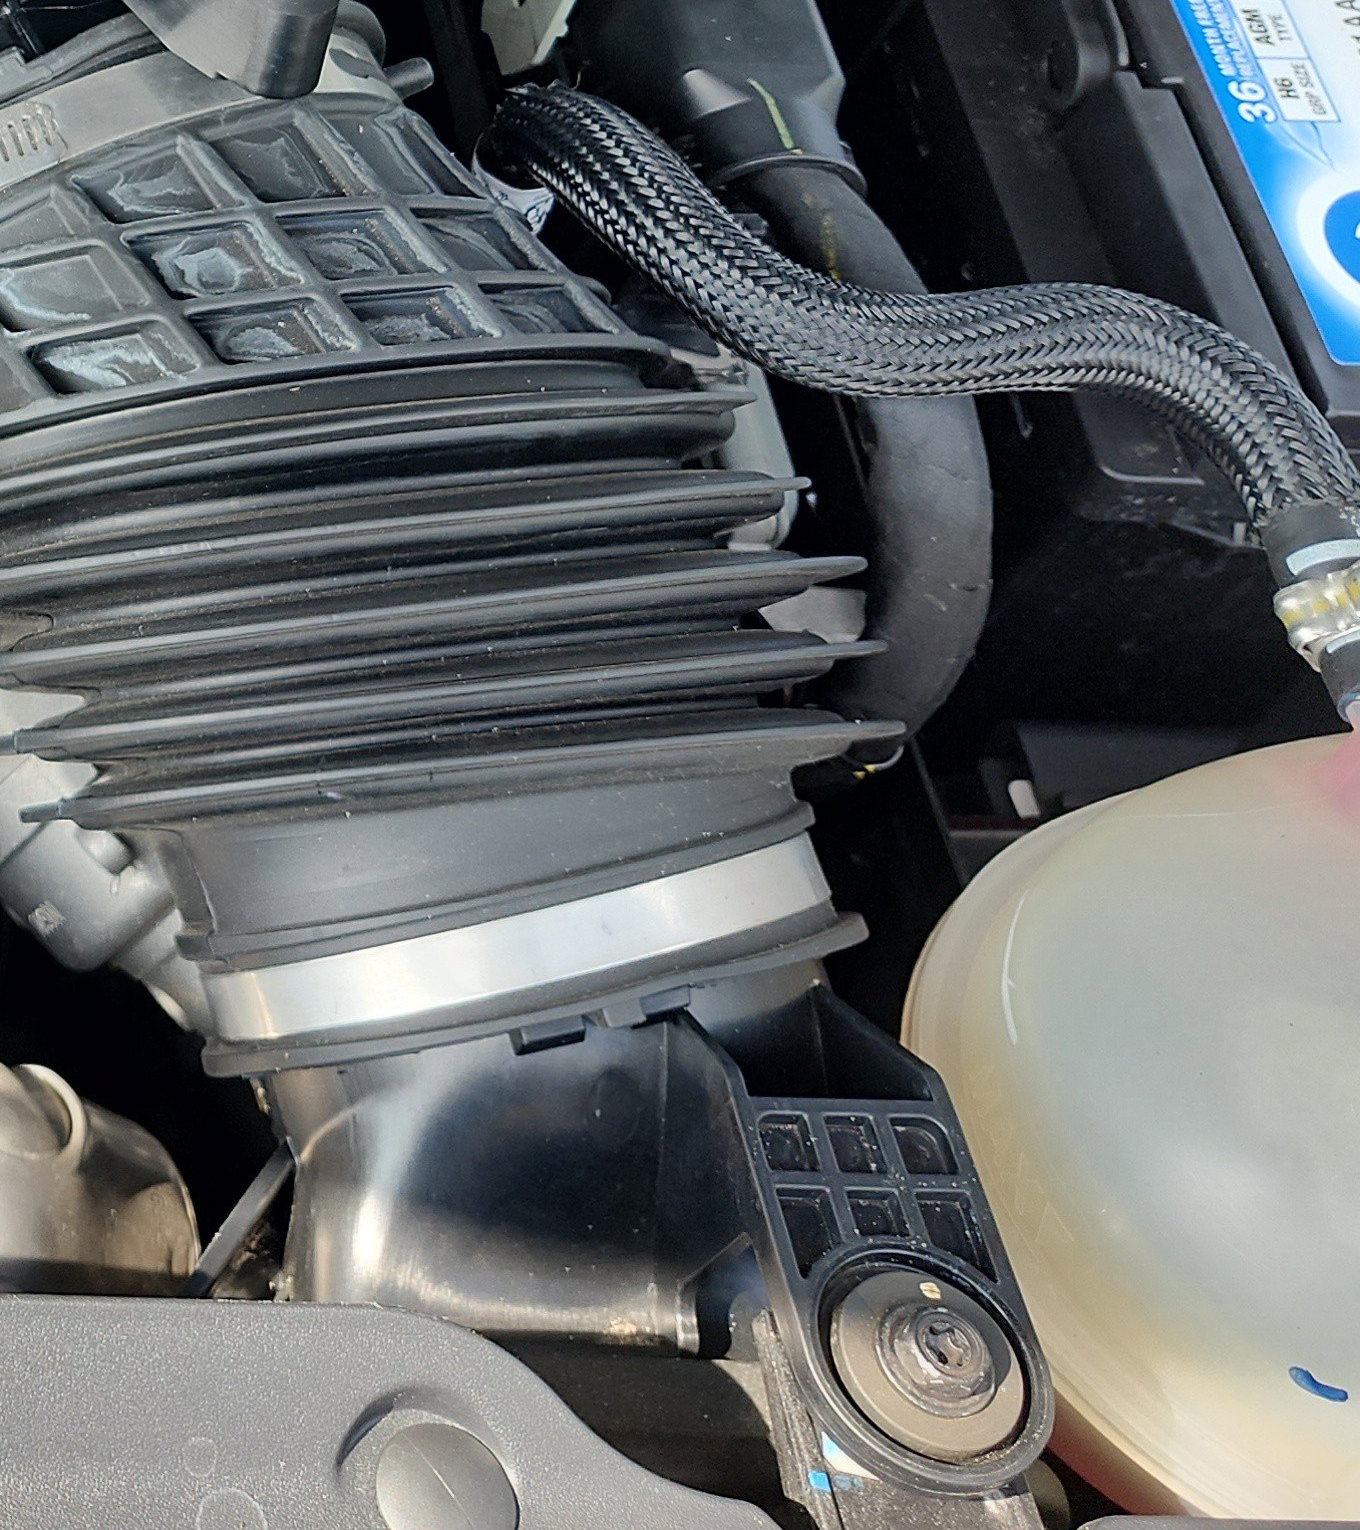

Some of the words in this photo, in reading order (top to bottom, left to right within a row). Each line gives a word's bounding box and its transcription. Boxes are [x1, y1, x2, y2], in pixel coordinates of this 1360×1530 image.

[1241, 8, 1271, 45] AGM
[1271, 14, 1291, 40] TYPE
[1202, 27, 1239, 76] MONTH
[1273, 78, 1298, 98] H6
[1292, 64, 1314, 87] SIZE
[1227, 80, 1278, 122] 36
